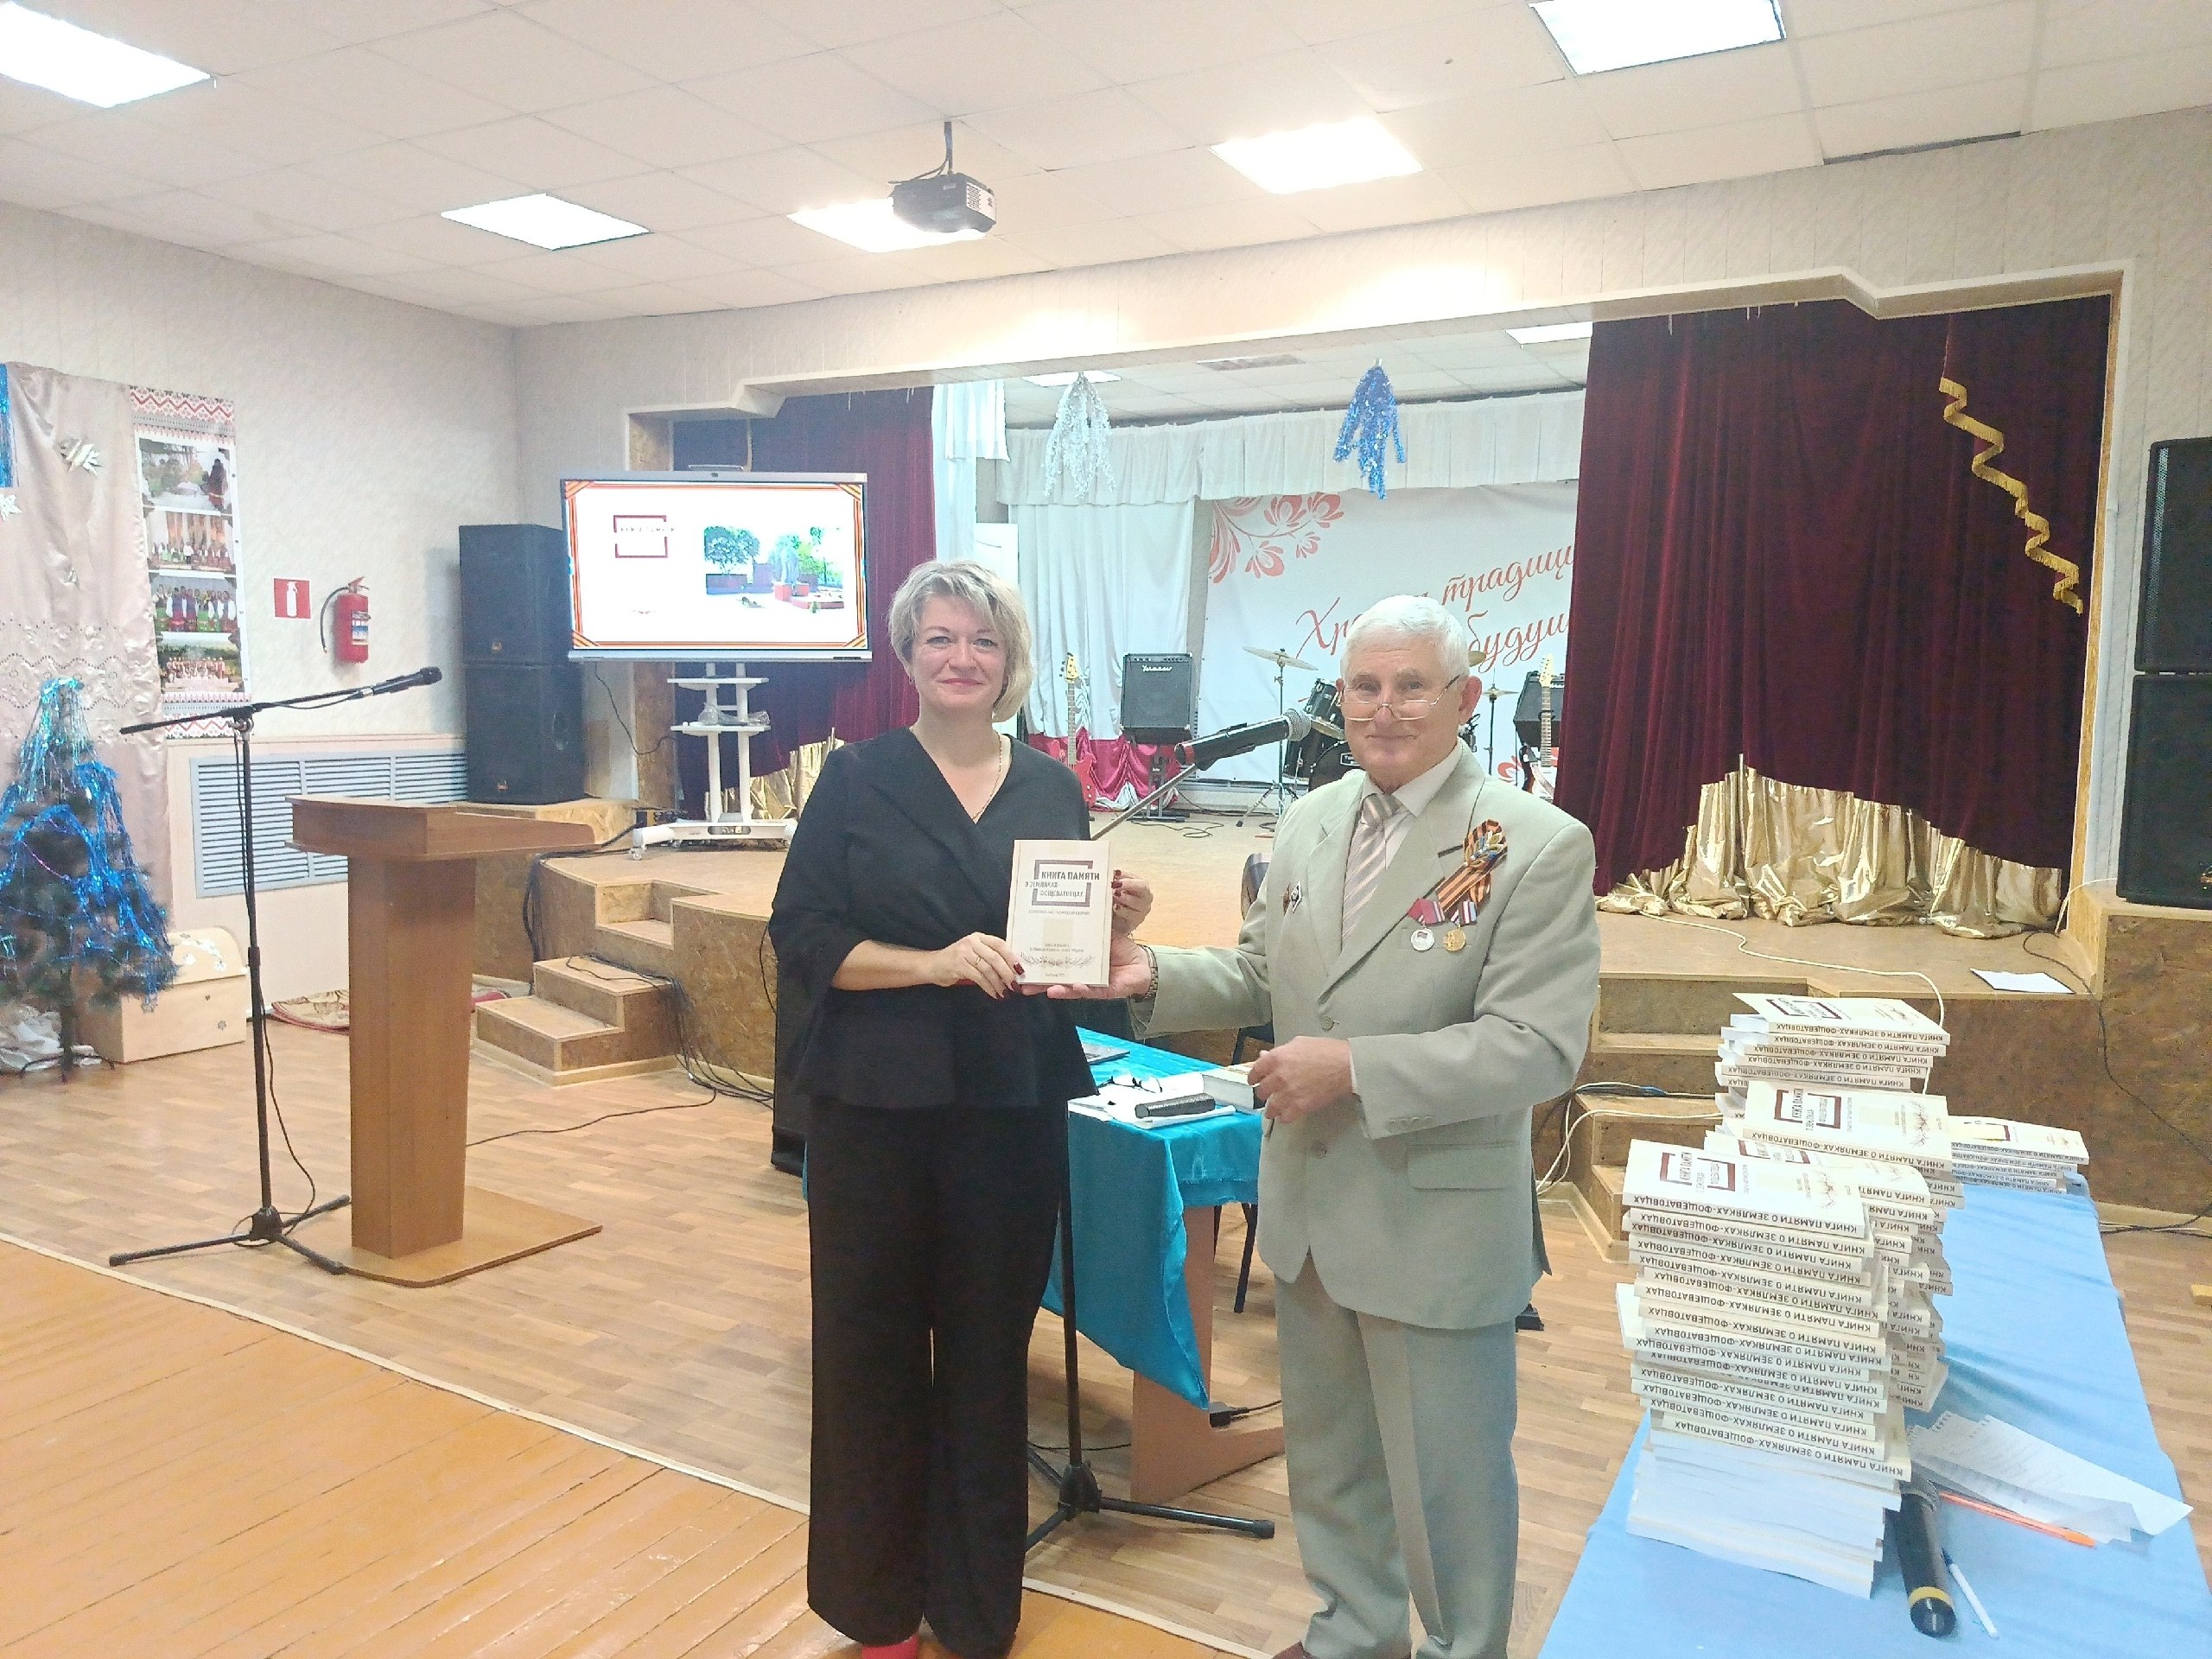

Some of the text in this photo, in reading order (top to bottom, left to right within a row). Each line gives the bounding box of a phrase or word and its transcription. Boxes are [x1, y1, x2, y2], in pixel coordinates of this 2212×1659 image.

[1041, 871, 1065, 880] КНИГА
[1863, 1064, 1893, 1072] ПАМЯТИ
[1896, 1065, 1921, 1074] КНИГА
[1844, 1076, 1876, 1084] ПАМЯТИ
[1878, 1152, 1913, 1163] ПАМЯТИ
[1916, 1157, 1944, 1168] КНИГА
[1927, 1182, 1955, 1192] КНИГА
[1896, 1192, 1925, 1203] КНИГА
[1869, 1205, 1896, 1216] ПАМЯ
[1898, 1210, 1928, 1220] КНИГА
[1781, 1216, 1821, 1228] ПАМЯТИ
[1825, 1221, 1857, 1233] КНИГА
[1880, 1222, 1910, 1232] КНИГА
[1918, 1223, 1939, 1232] КНИ
[1789, 1235, 1829, 1249] ПАМЯТИ
[1833, 1242, 1865, 1254] КНИГА
[1875, 1237, 1905, 1249] КНИГА
[1776, 1249, 1816, 1262] ПАМЯТИ
[1918, 1246, 1936, 1255] КНИ
[1820, 1256, 1852, 1269] КНИГА
[1881, 1255, 1900, 1264] КНИ
[1775, 1262, 1781, 1271] О
[1783, 1264, 1825, 1278] ПАМЯТИ
[1828, 1271, 1860, 1283] КНИГА
[1893, 1267, 1924, 1279] КНИГА
[1785, 1282, 1826, 1297] ПАМЯТИ
[1918, 1282, 1947, 1293] КНИГА
[1829, 1290, 1861, 1303] КНИГА
[1801, 1298, 1841, 1312] ПАМЯТИ
[1785, 1310, 1791, 1319] О
[1794, 1312, 1834, 1325] ПАМЯТИ
[1846, 1306, 1878, 1319] КНИГА
[1892, 1312, 1923, 1322] КНИГА
[1838, 1319, 1871, 1332] КНИГА
[1891, 1324, 1921, 1335] КНИГА
[1789, 1331, 1796, 1339] О
[1798, 1332, 1840, 1347] ПАМЯТИ
[1796, 1345, 1802, 1354] О
[1804, 1346, 1846, 1359] ПАМЯТИ
[1844, 1340, 1876, 1353] КНИГА
[1907, 1343, 1926, 1352] КНИ
[1785, 1358, 1826, 1370] ПАМЯТИ
[1849, 1352, 1881, 1364] КНИГА
[1829, 1364, 1861, 1376] КНИГА
[1800, 1375, 1840, 1389] ПАМЯТИ
[1844, 1382, 1877, 1394] КНИГА
[1802, 1386, 1843, 1400] ПАМЯТИ
[1897, 1384, 1923, 1394] КНИГ
[1778, 1394, 1785, 1403] О
[1787, 1395, 1828, 1412] ПАМЯТИ
[1847, 1395, 1879, 1407] КНИГА
[1781, 1411, 1788, 1420] О
[1832, 1404, 1864, 1418] КНИГА
[1789, 1413, 1831, 1428] ПАМЯТИ
[1789, 1428, 1795, 1438] О
[1834, 1421, 1866, 1435] КНИГА
[1797, 1430, 1839, 1447] ПАМЯТИ
[1842, 1440, 1875, 1454] КНИГА
[1815, 1450, 1821, 1459] О
[1824, 1452, 1866, 1468] ПАМЯТИ
[1870, 1461, 1903, 1476] КНИГА
